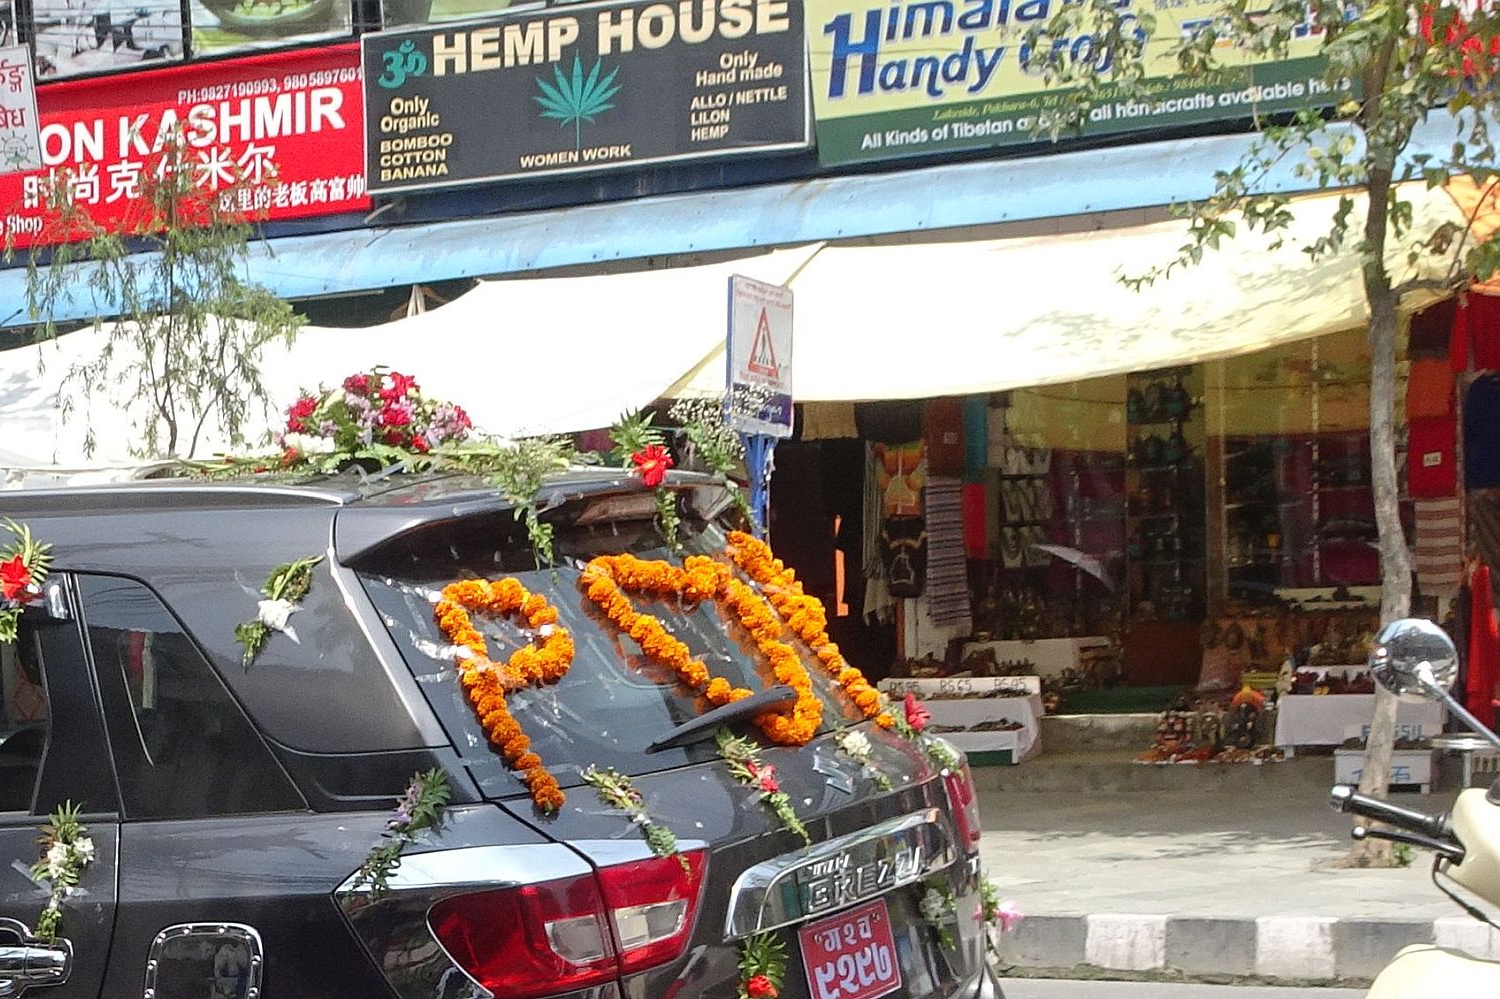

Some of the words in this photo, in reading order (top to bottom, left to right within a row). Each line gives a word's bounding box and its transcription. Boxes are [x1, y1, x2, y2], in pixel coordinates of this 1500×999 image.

[432, 17, 579, 77] HEMP
[598, 0, 790, 56] HOUSE
[719, 50, 759, 73] Only
[695, 68, 739, 87] Hand
[741, 63, 783, 80] made
[390, 95, 430, 119] Only
[690, 94, 725, 111] ALLO
[736, 85, 789, 105] NETTLE
[119, 87, 347, 159] KASHMIR
[380, 111, 441, 134] Organic
[690, 109, 731, 127] LILON
[861, 132, 883, 150] All
[885, 125, 929, 147] Kinds
[931, 124, 949, 140] of
[950, 117, 1013, 139] Tibetan
[1090, 103, 1113, 122] all
[1218, 80, 1305, 106] avalable
[380, 134, 453, 153] BOMBOO
[690, 125, 730, 142] HEMP
[380, 149, 447, 168] COTTON
[519, 150, 579, 169] WOMEN
[582, 143, 632, 160] WORK
[380, 163, 449, 182] BANANA
[6, 214, 43, 236] Shop
[822, 927, 842, 952] ग
